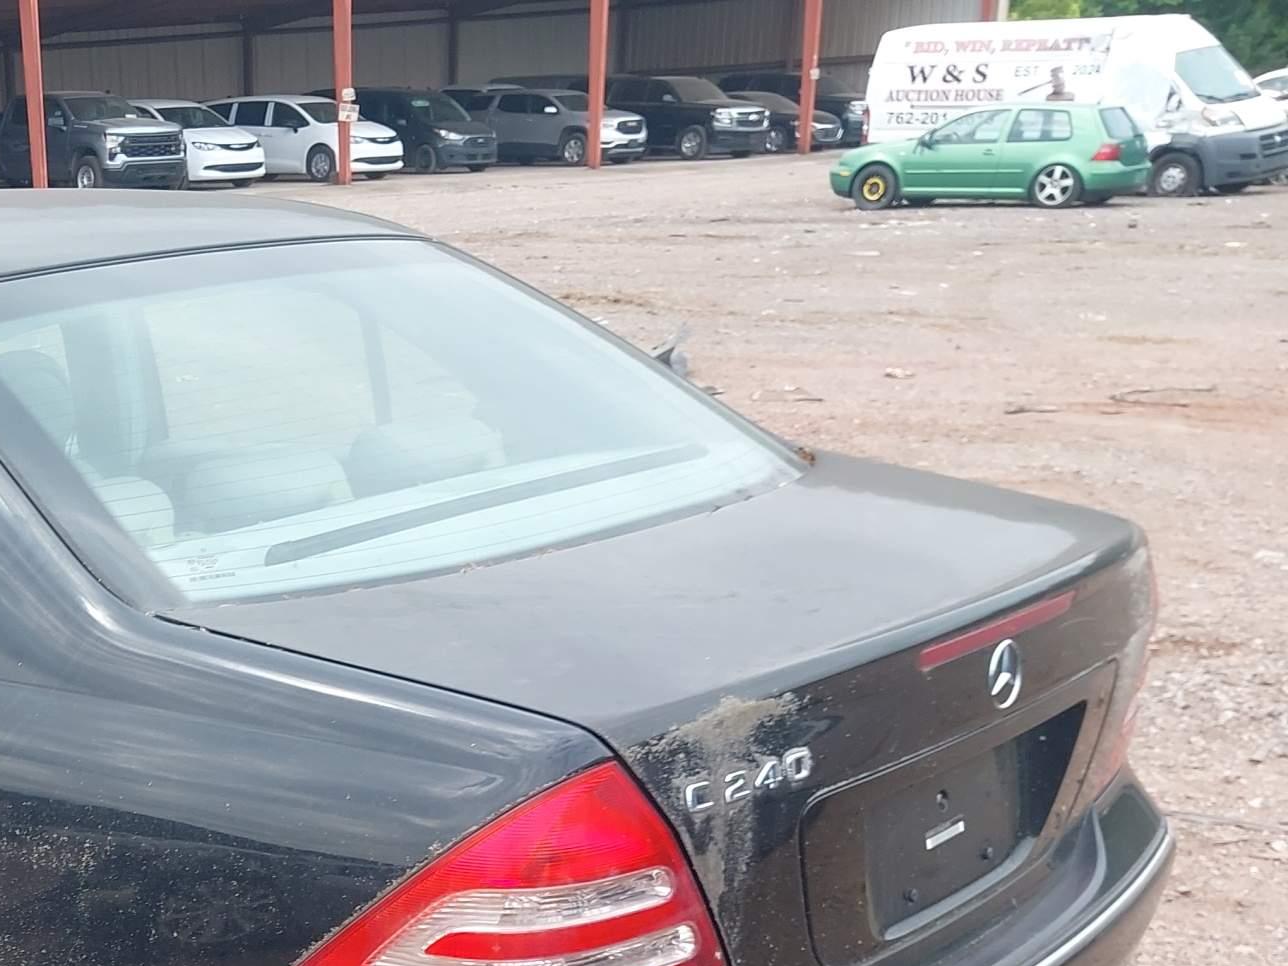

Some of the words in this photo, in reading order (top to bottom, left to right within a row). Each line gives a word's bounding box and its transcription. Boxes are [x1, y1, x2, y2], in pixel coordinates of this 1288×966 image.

[908, 64, 937, 84] W
[942, 64, 964, 83] &
[972, 63, 989, 83] S
[885, 89, 951, 102] AUCTION
[954, 88, 1004, 101] HOUSE
[685, 780, 715, 813] C
[724, 747, 811, 804] 240
